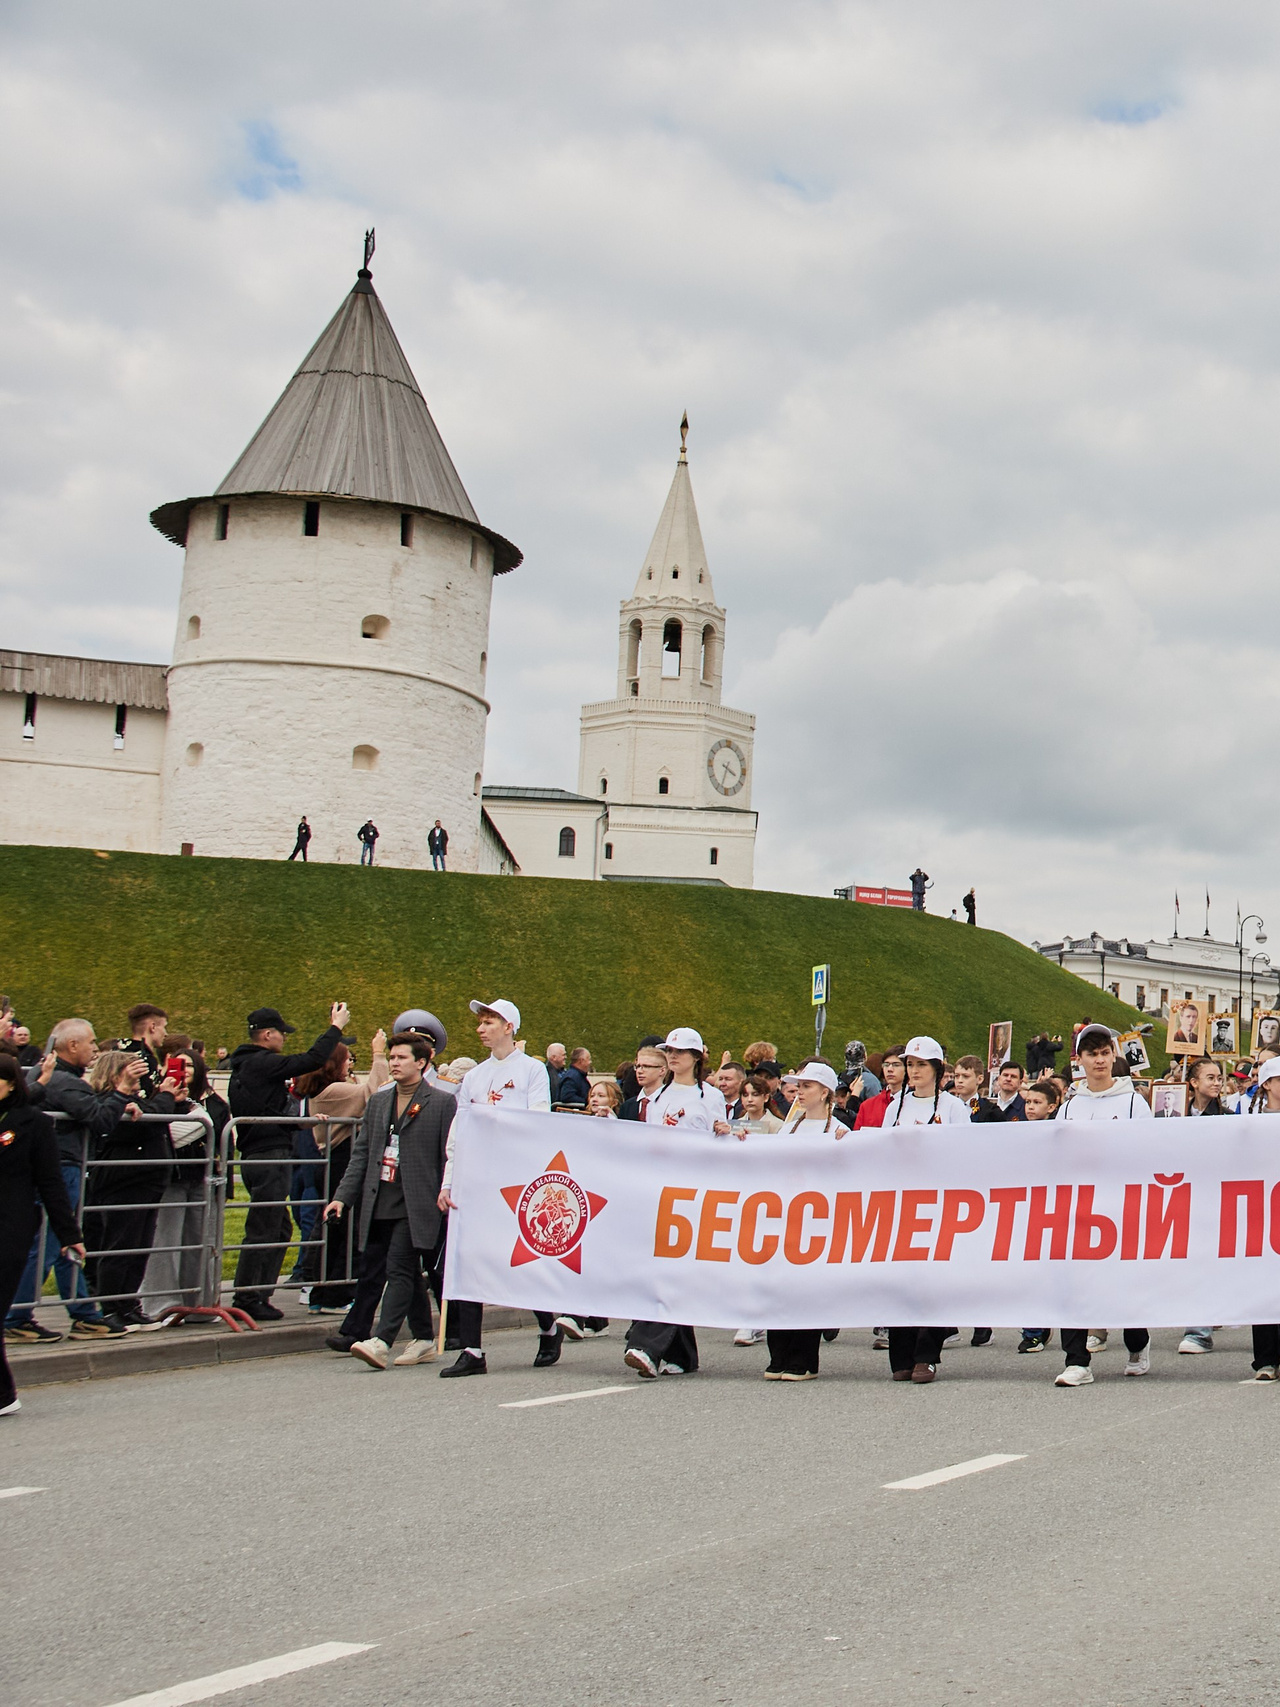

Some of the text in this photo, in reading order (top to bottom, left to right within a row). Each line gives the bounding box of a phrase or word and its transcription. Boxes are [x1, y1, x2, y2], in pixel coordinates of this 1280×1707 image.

[525, 1188, 536, 1200] ЛЕТ
[535, 1175, 570, 1187] ВЕЛИКОЙ
[570, 1183, 586, 1217] ПОБЕДЫ
[654, 1172, 1191, 1264] БЕССМЕРТНЫЙ
[533, 1243, 546, 1252] 1941
[555, 1244, 568, 1253] 1945
